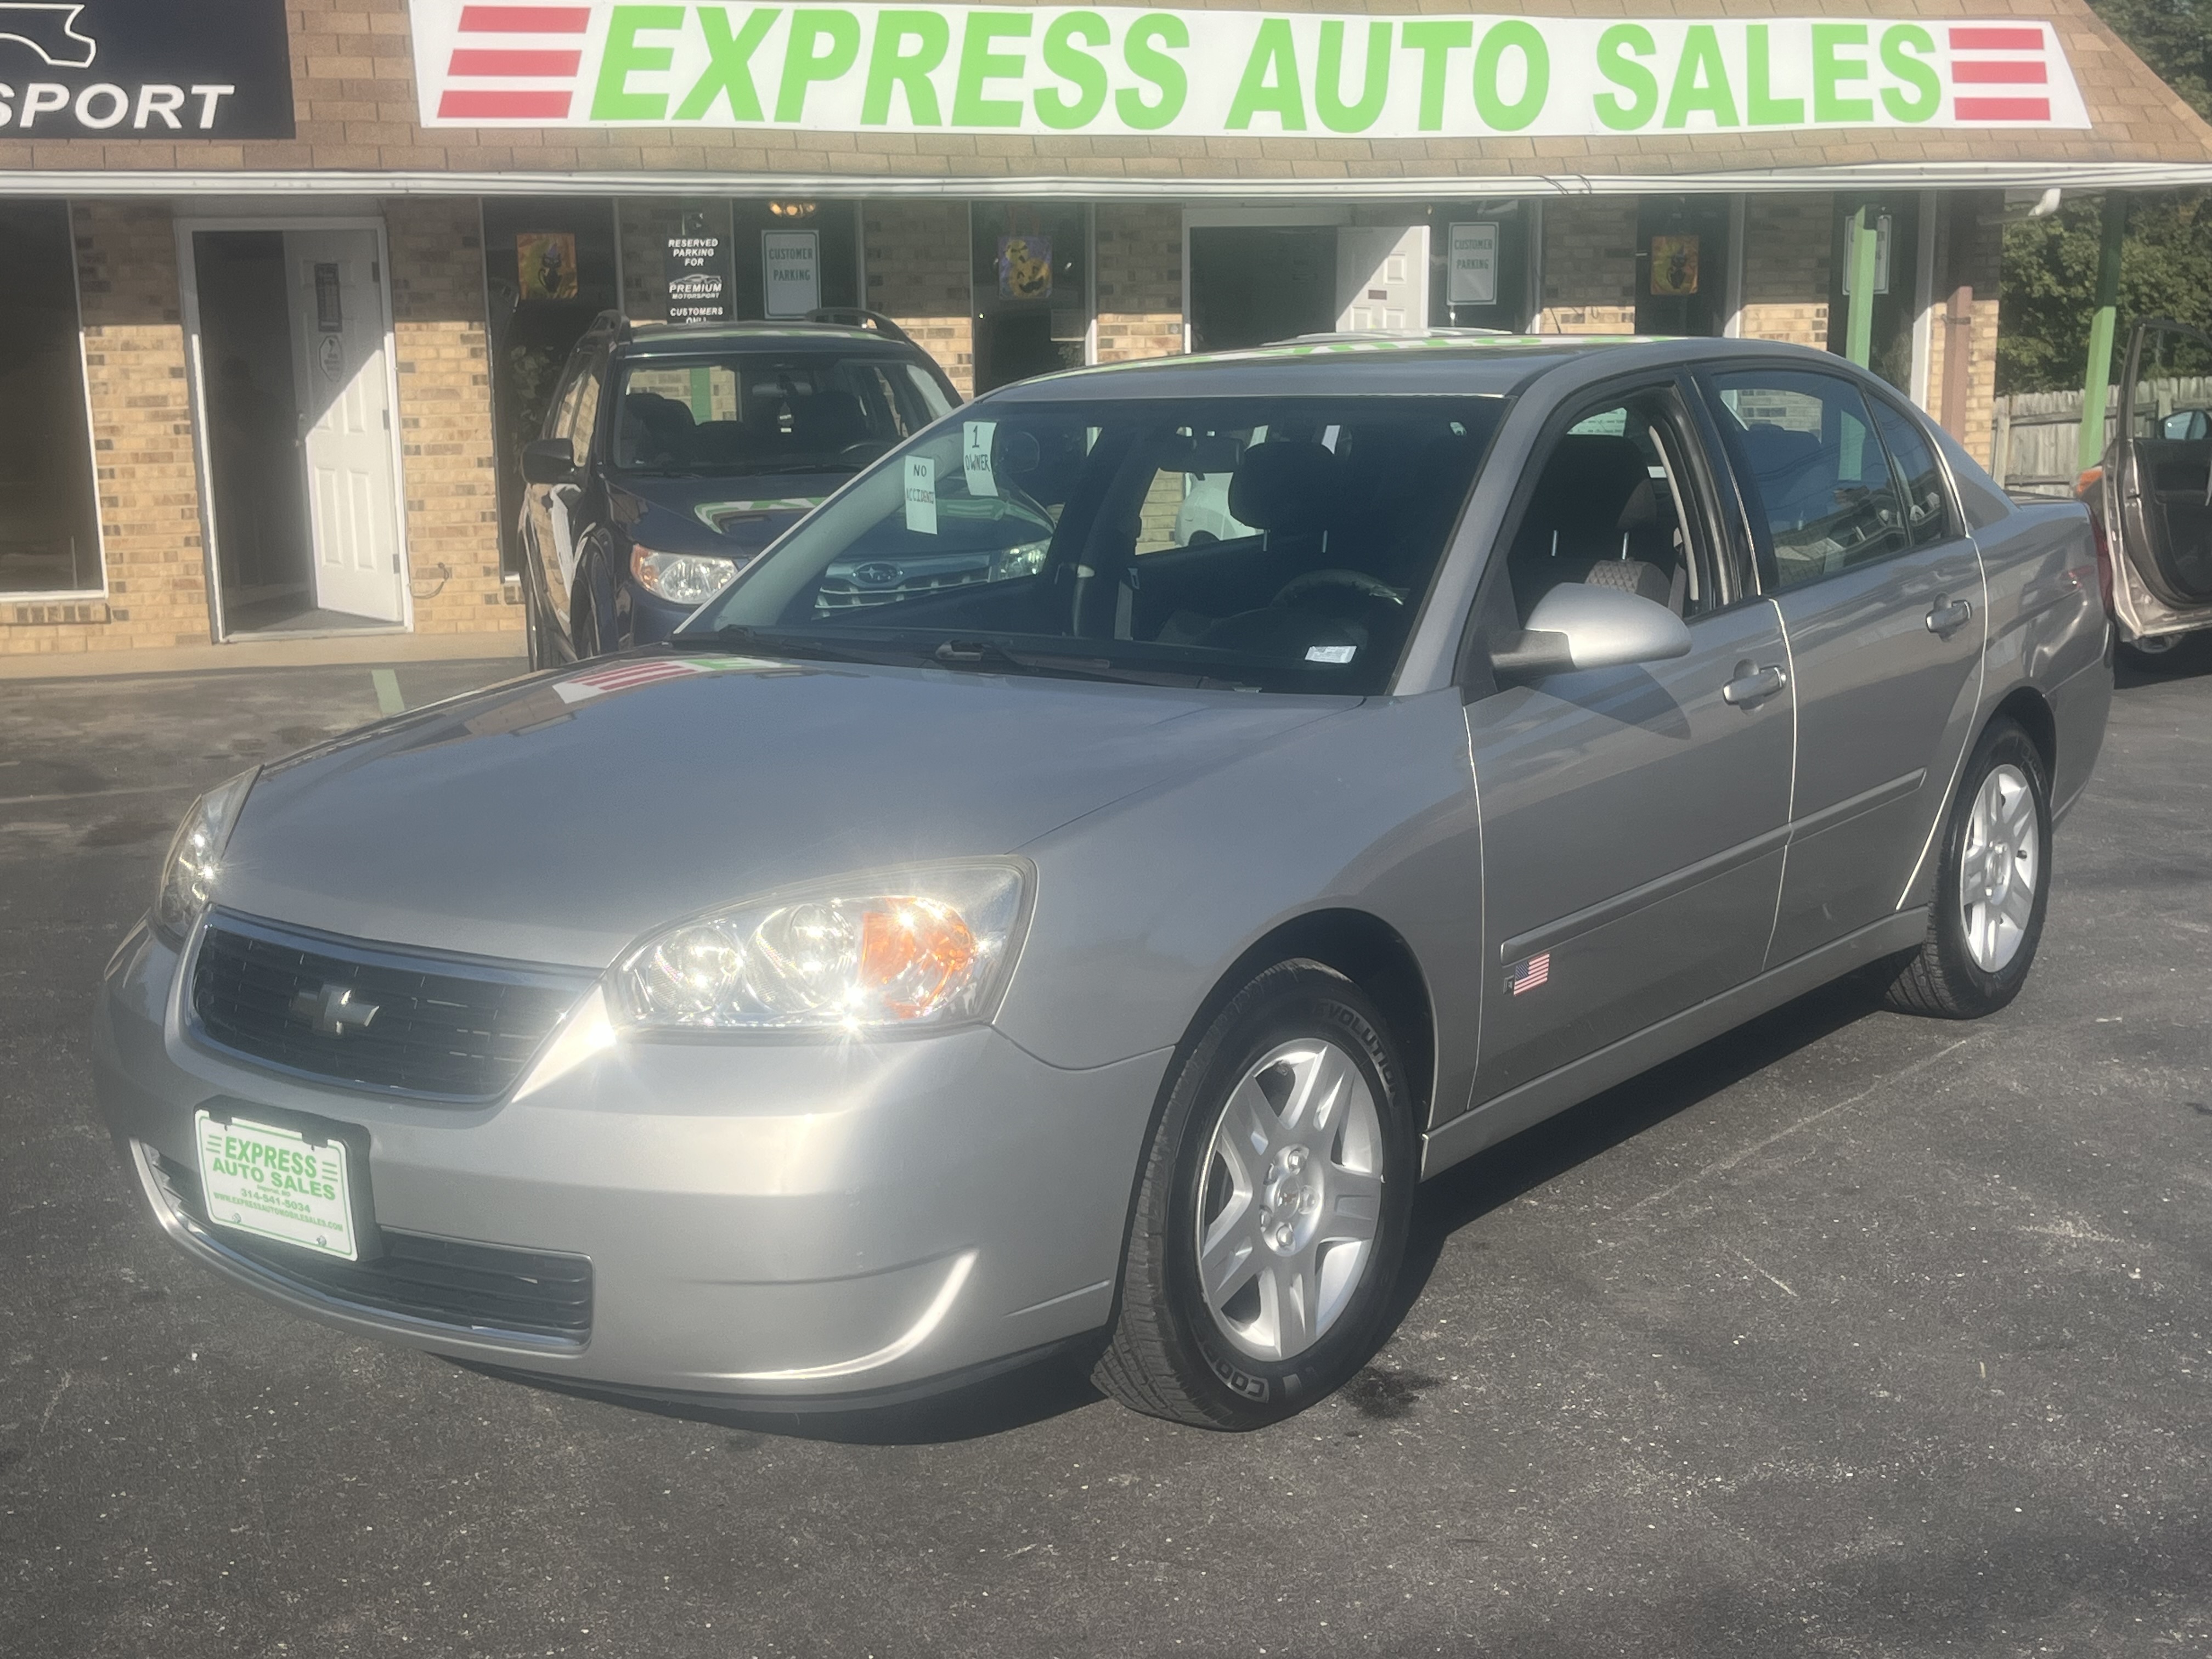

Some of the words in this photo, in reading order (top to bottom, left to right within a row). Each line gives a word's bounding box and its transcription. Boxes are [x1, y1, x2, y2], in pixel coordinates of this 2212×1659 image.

[590, 5, 1189, 129] EXPRESS
[1224, 18, 1549, 133] AUTO
[1594, 24, 1940, 131] SALES
[668, 238, 719, 247] RESERVED
[1454, 238, 1493, 250] CUSTOMER
[673, 249, 714, 257] PARKING
[769, 248, 813, 260] CUSTOMER
[684, 257, 704, 267] FOR
[1457, 258, 1489, 269] PARKING
[773, 269, 811, 281] PARKING
[669, 284, 721, 293] PREMIUM
[670, 307, 723, 317] CUSTOMERS
[972, 425, 979, 448] 1
[964, 454, 990, 472] OWNER
[913, 464, 927, 477] NO
[225, 1136, 317, 1178] EXPRESS
[213, 1158, 264, 1183] AUTO
[271, 1172, 336, 1200] SALES
[241, 1188, 311, 1213] 314-541-5034
